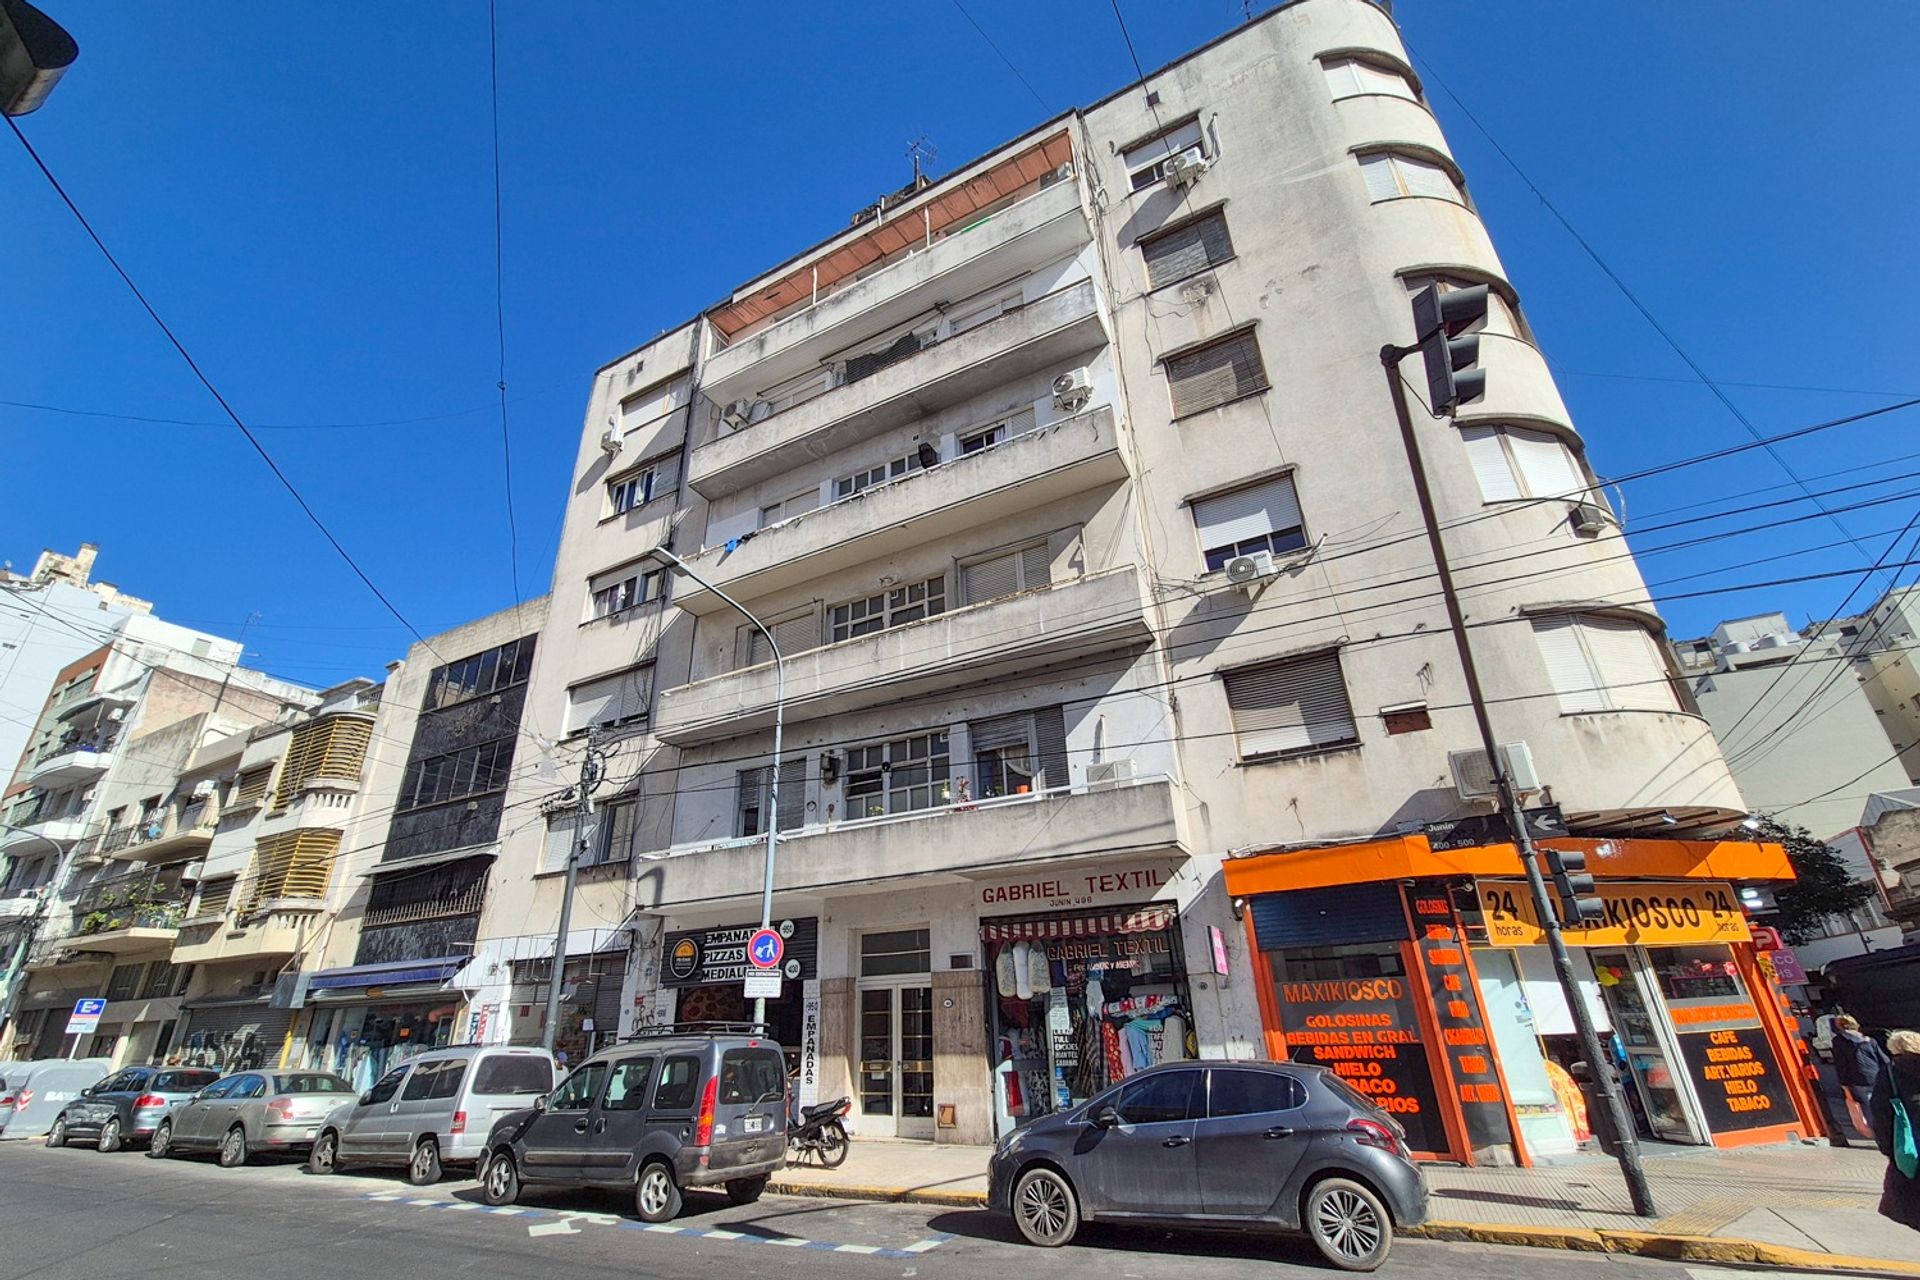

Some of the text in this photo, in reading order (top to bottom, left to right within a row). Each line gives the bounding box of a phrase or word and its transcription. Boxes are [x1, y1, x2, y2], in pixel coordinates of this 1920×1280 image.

[1457, 838, 1475, 847] 500
[982, 868, 1166, 903] GABRIEL TEXTIL
[1487, 890, 1518, 921] 24
[1705, 890, 1733, 918] 24
[1494, 923, 1524, 936] horas
[703, 949, 744, 962] PIZZAS
[1047, 938, 1170, 961] GABRIEL TEXTIL
[1283, 979, 1403, 1002] MAXIKIOSCO
[1306, 1013, 1392, 1028] GOLOSINAS
[1286, 1030, 1419, 1044] BEBIDAS EN GRAL
[1710, 1030, 1738, 1044] CAFE
[805, 1015, 817, 1085] EMPANADAS
[1313, 1045, 1396, 1060] SANDWICH
[1705, 1046, 1753, 1062] BEBIDAS
[1333, 1062, 1382, 1076] HIELO
[1723, 1079, 1758, 1094] HIELO
[1726, 1094, 1771, 1112] TABACO
